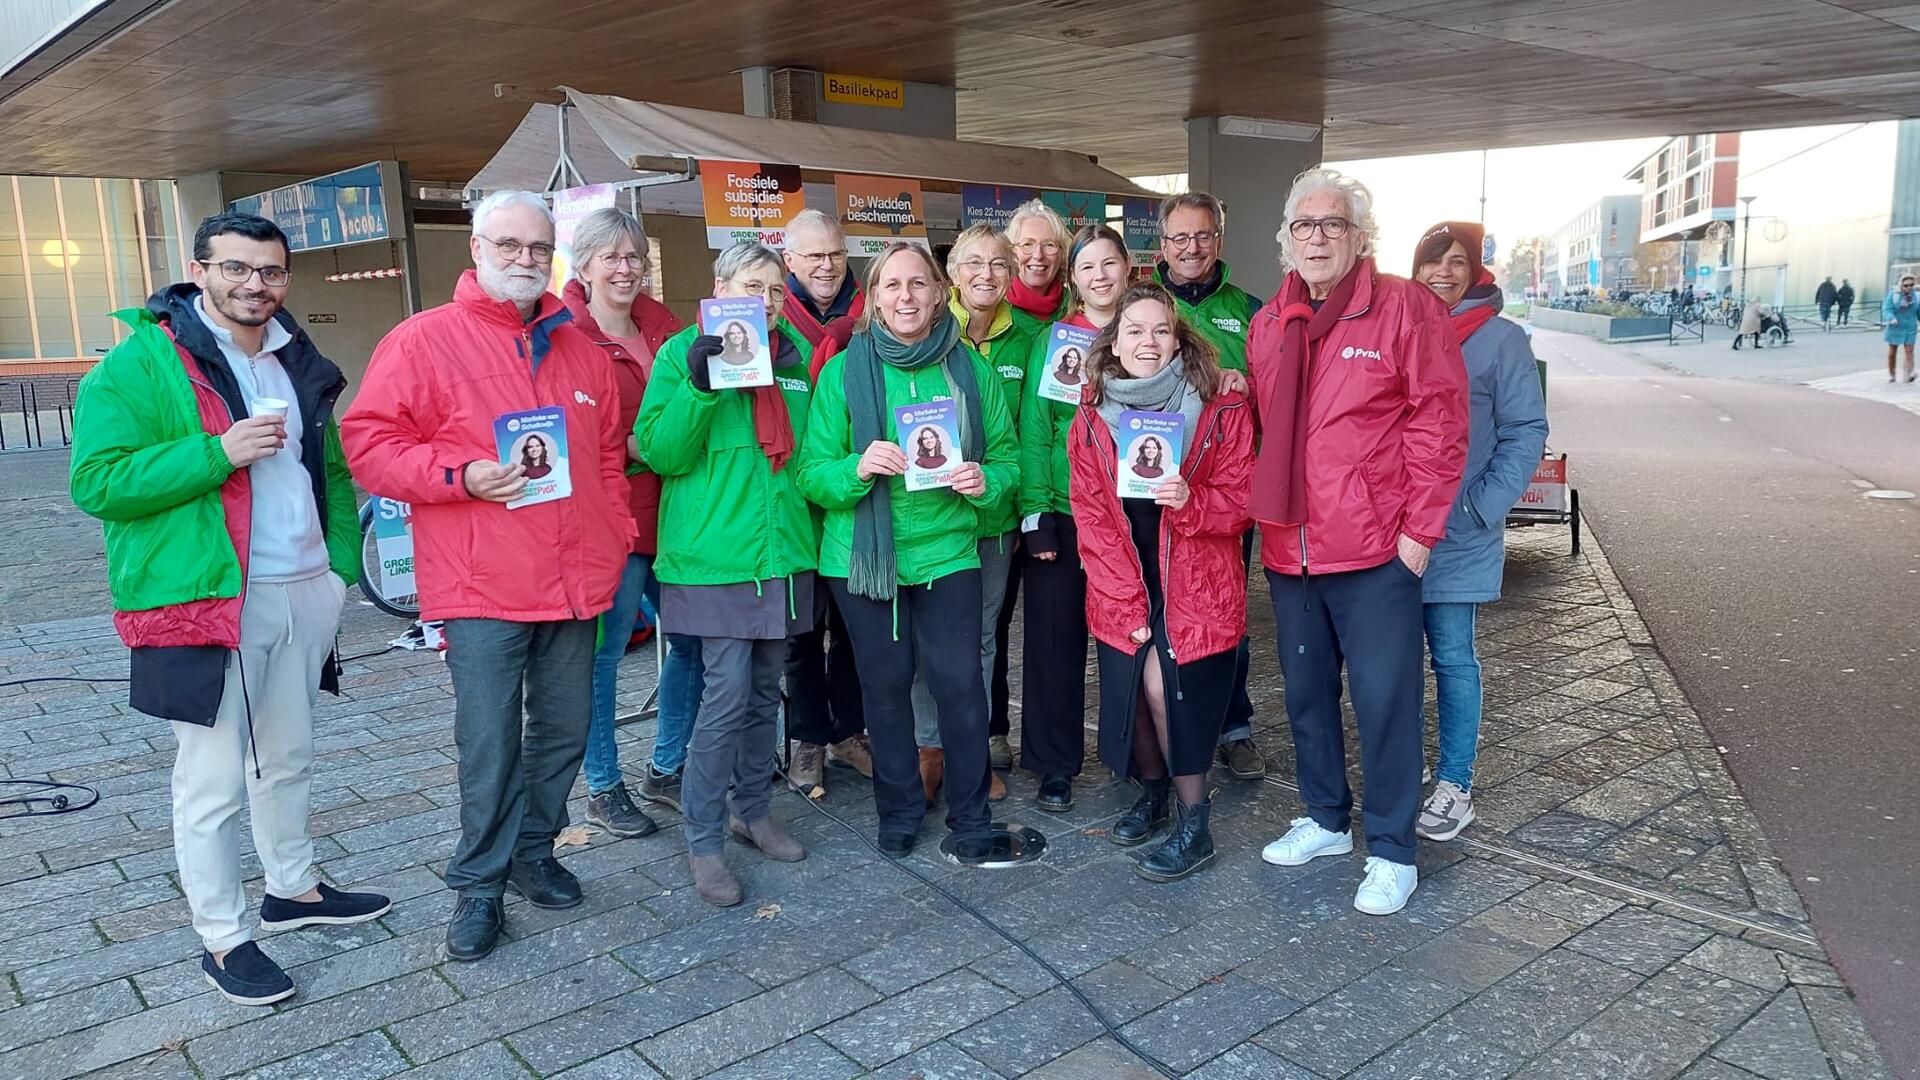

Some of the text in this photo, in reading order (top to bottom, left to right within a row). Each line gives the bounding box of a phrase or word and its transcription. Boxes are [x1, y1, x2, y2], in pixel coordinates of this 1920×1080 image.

[828, 78, 898, 101] Basiliekpad
[727, 173, 779, 190] Fossiele
[724, 189, 785, 205] subsidies
[848, 194, 912, 210] De Wadden
[729, 206, 782, 220] stoppen
[848, 209, 915, 224] beschermen
[967, 206, 983, 216] Kies
[984, 207, 993, 216] 22
[1073, 216, 1099, 226] natuur
[1126, 217, 1139, 226] Kies
[1140, 218, 1147, 226] 22
[758, 231, 783, 245] PvdA
[1212, 317, 1240, 326] GROEN
[1218, 324, 1240, 333] LINKS
[1521, 489, 1544, 503] vdA
